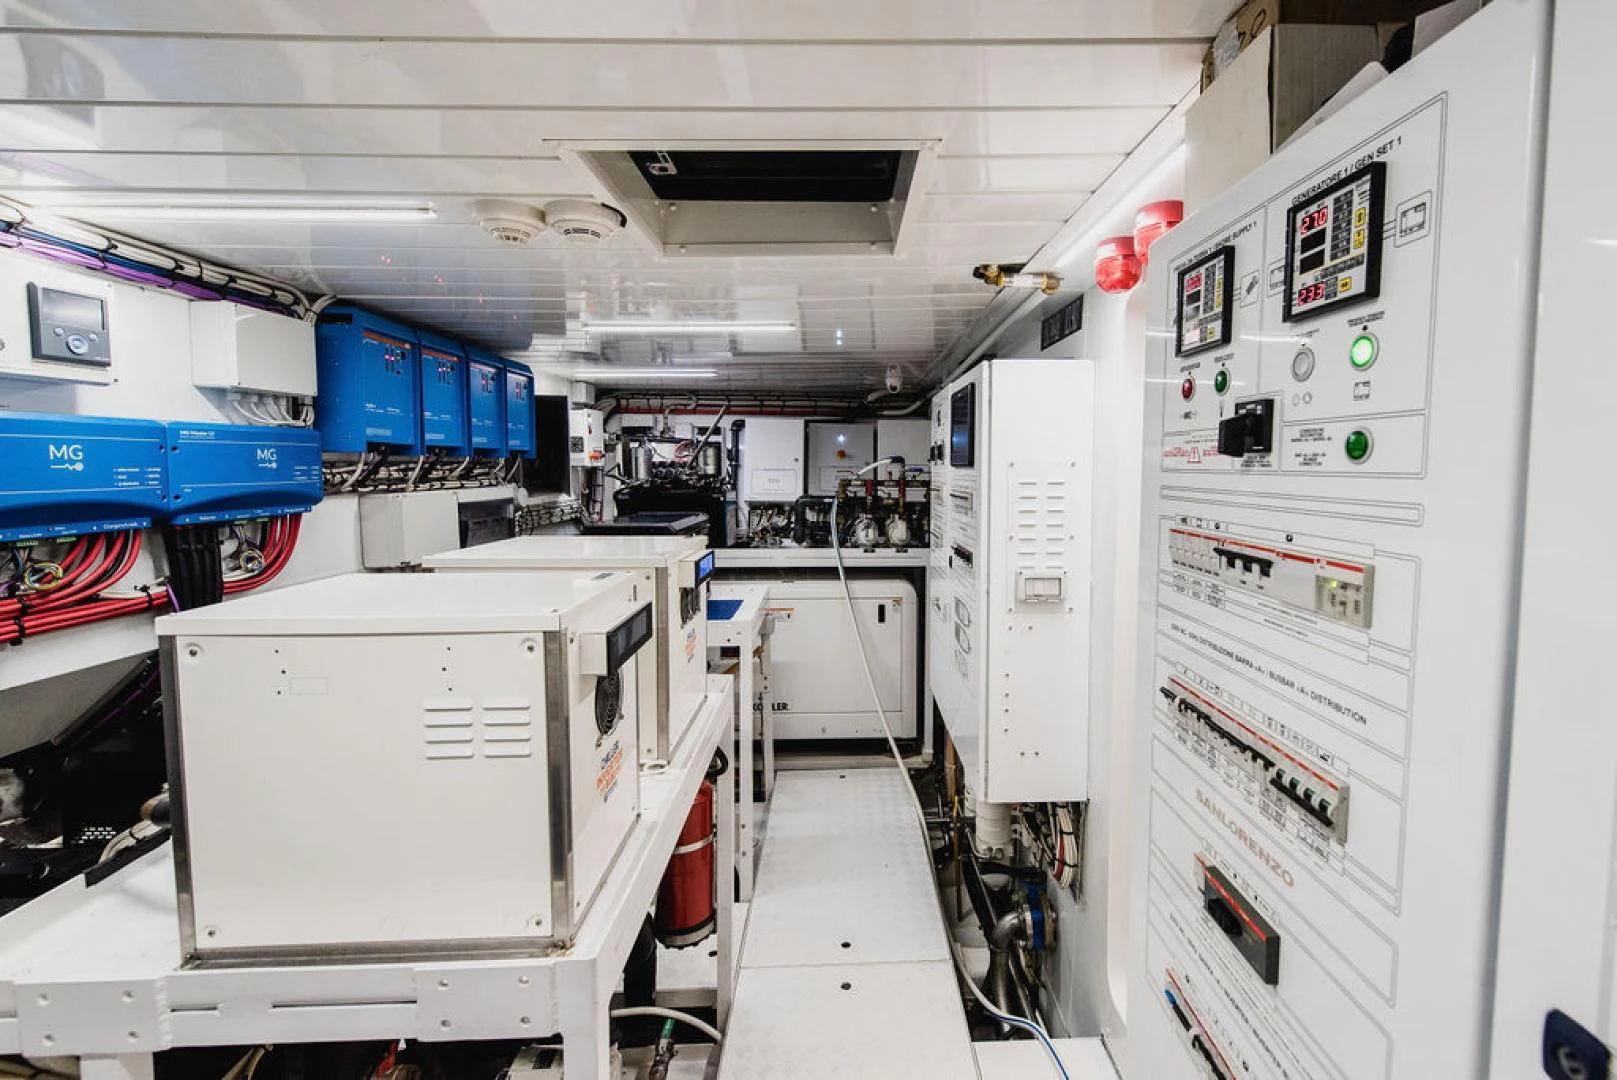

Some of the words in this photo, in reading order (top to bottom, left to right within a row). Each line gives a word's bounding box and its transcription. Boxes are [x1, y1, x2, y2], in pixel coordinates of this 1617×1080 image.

[1354, 151, 1375, 171] GEN
[1376, 138, 1395, 159] SET
[1297, 281, 1326, 307] 233
[48, 444, 83, 460] MG
[256, 448, 277, 461] MG
[1310, 690, 1367, 725] DISTRIBUTION
[1196, 787, 1294, 887] SANLORENZO
